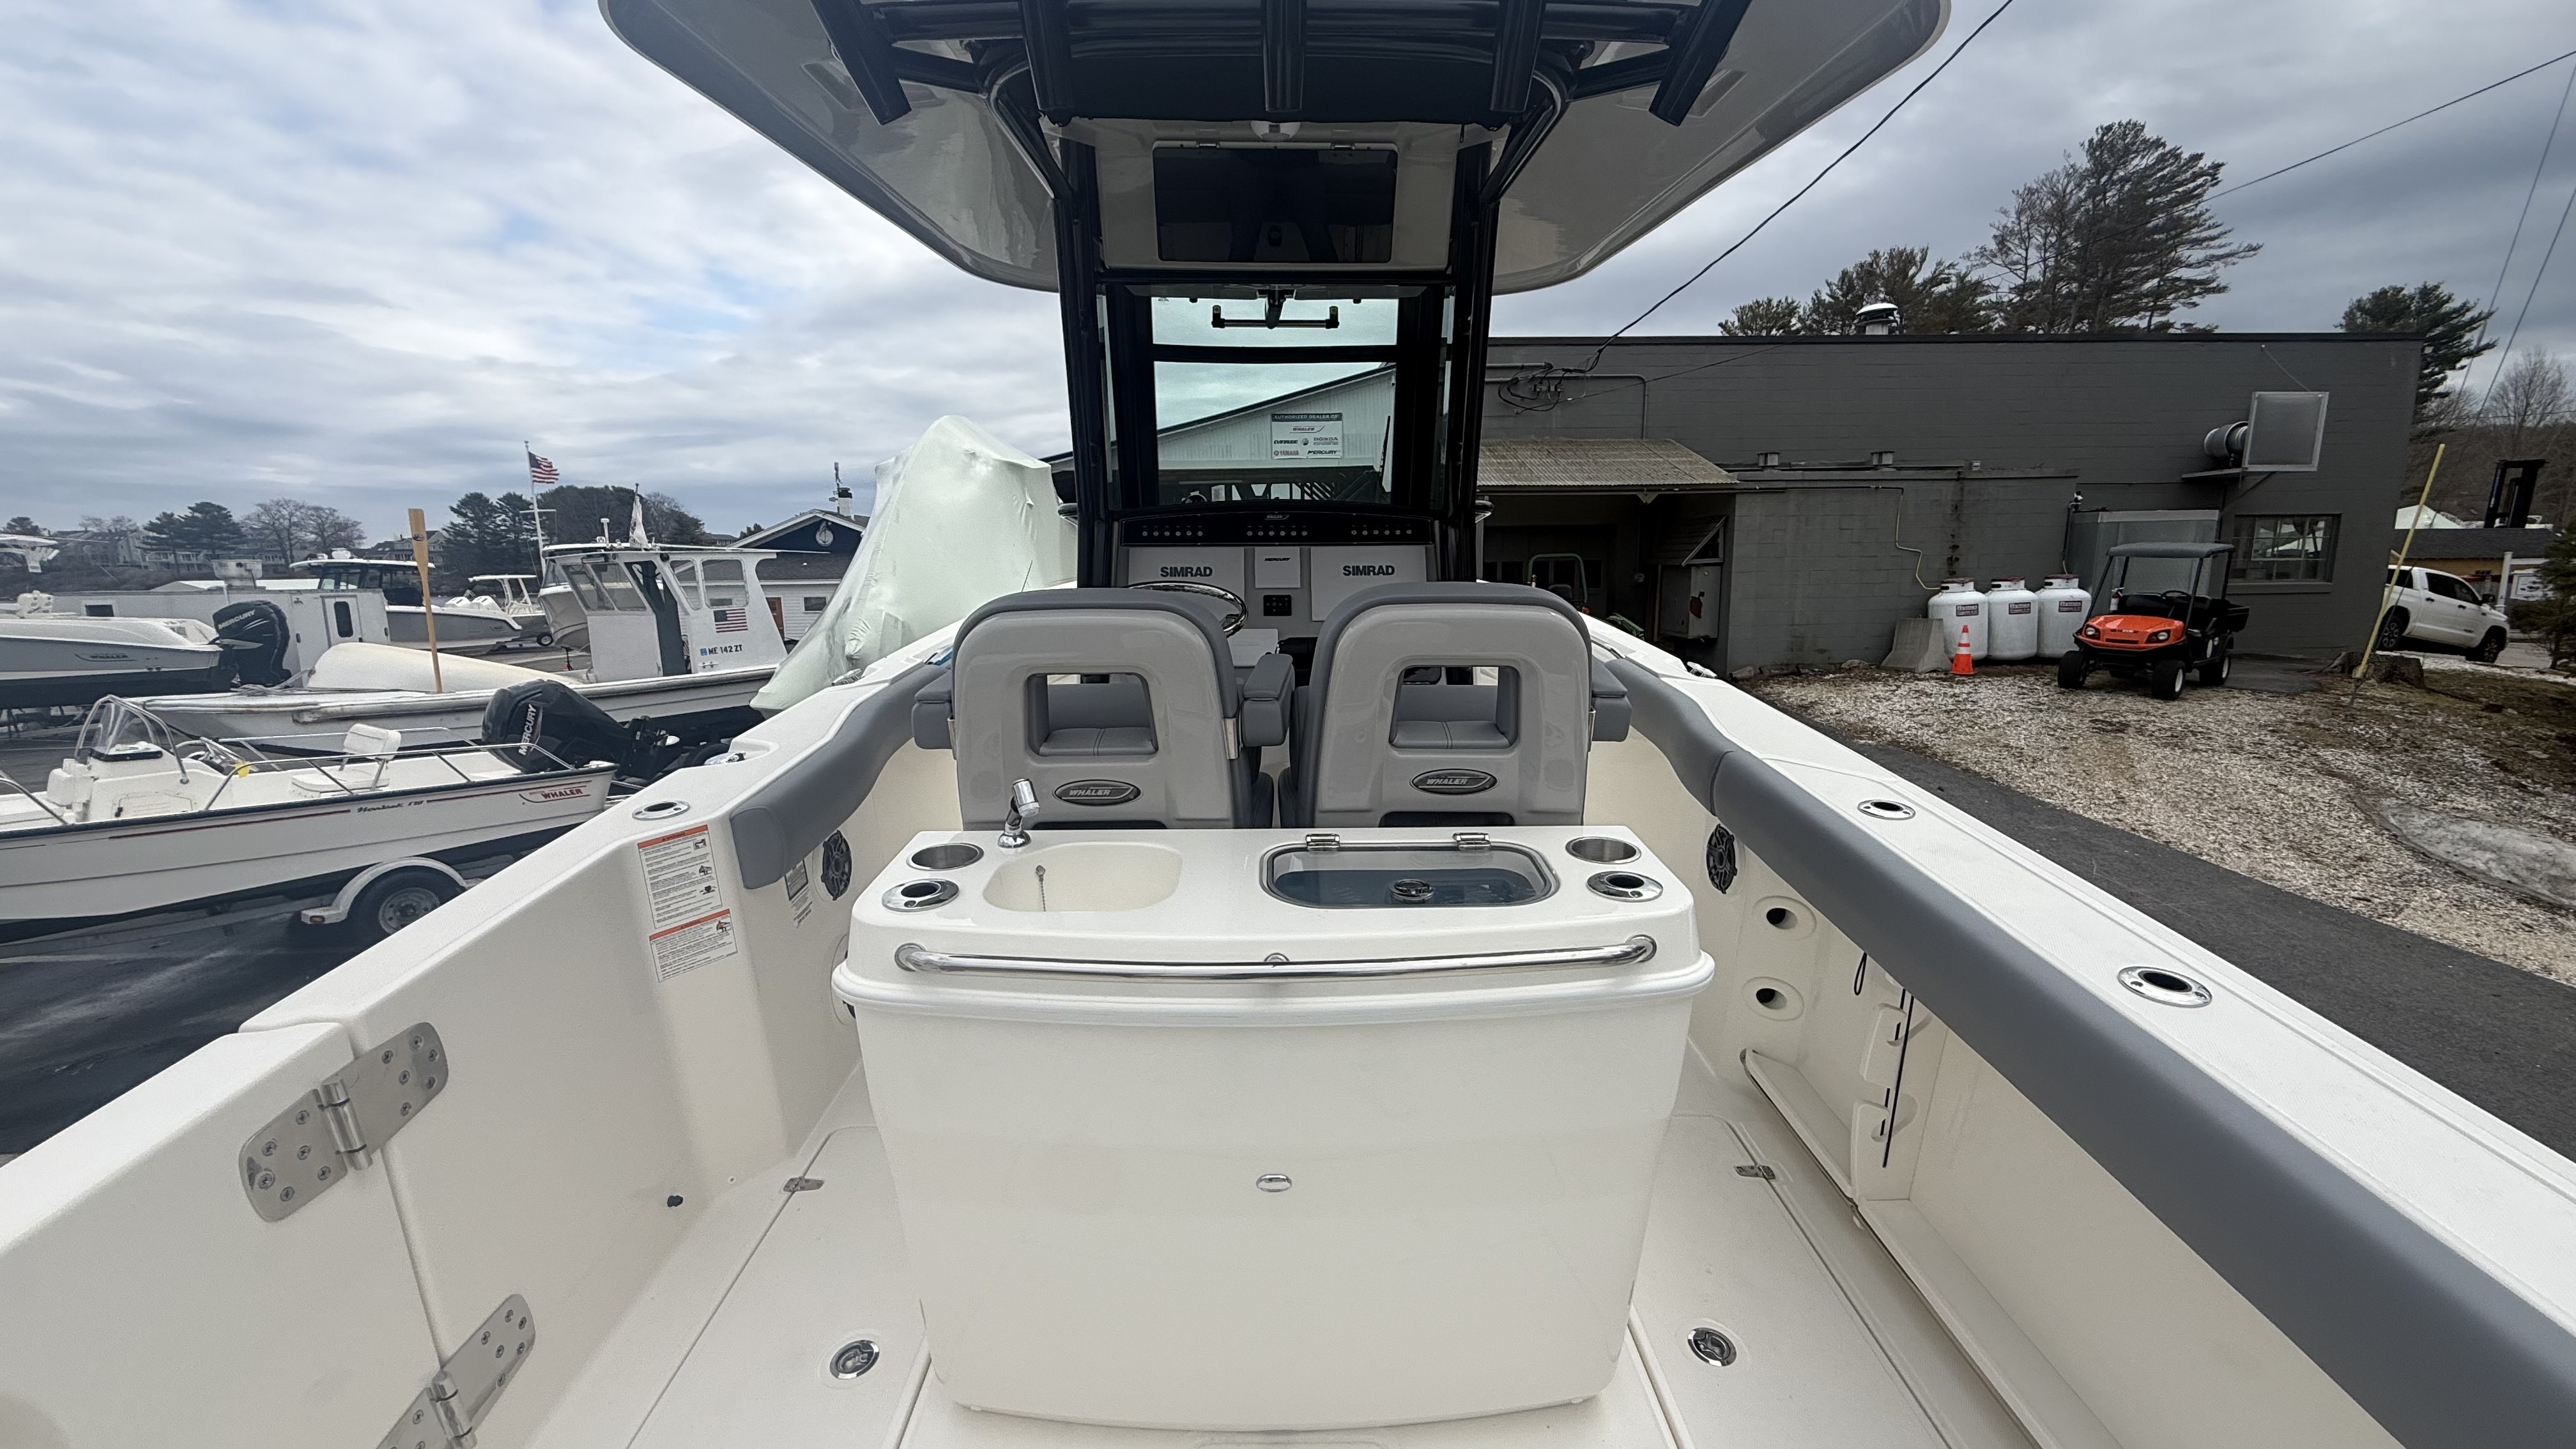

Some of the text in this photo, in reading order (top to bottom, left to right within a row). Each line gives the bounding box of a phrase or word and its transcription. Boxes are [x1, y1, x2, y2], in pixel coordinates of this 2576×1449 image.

[1160, 567, 1213, 578] SIMRAD
[1342, 565, 1395, 576] SIMRAD
[218, 609, 256, 629] MERCURY
[518, 703, 537, 756] MERCURY
[541, 788, 583, 799] WHALER
